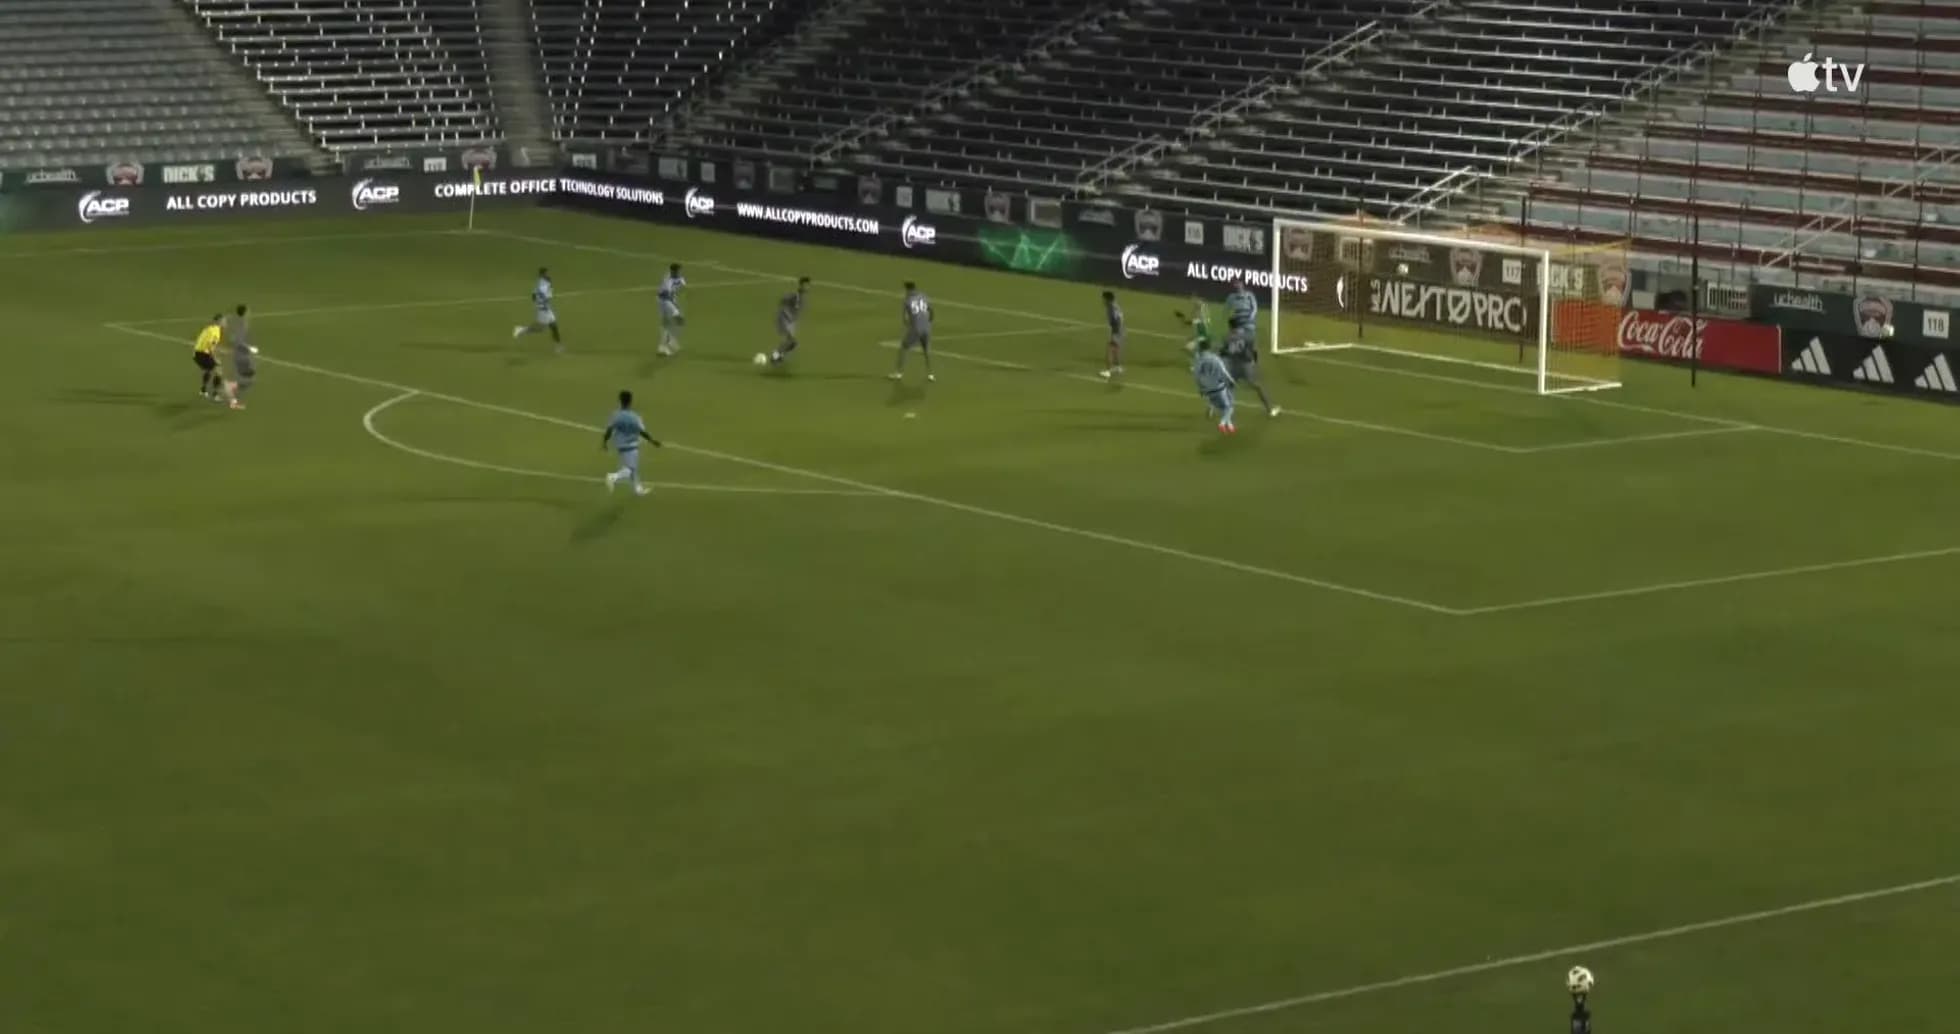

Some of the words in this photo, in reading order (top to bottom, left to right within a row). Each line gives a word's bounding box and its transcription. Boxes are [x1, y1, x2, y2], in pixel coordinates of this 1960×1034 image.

[166, 195, 194, 210] ALL
[197, 194, 236, 208] COPY
[240, 190, 317, 206] PRODUCTS
[358, 186, 399, 200] ACP
[434, 182, 507, 198] COMPLETE
[510, 178, 556, 194] OFFICE
[560, 178, 614, 198] TECHNOLOGY
[615, 186, 664, 205] SOLUTIONS
[86, 198, 130, 213] ACP
[690, 196, 715, 210] ACP
[736, 202, 879, 234] WWW.ALLCOPYPRODUCTS.COM
[907, 225, 937, 240] ACP
[1128, 255, 1160, 270] ACP
[1187, 262, 1209, 279] ALL
[1211, 265, 1242, 282] COPY
[1618, 310, 1707, 358] Coca-Cola
